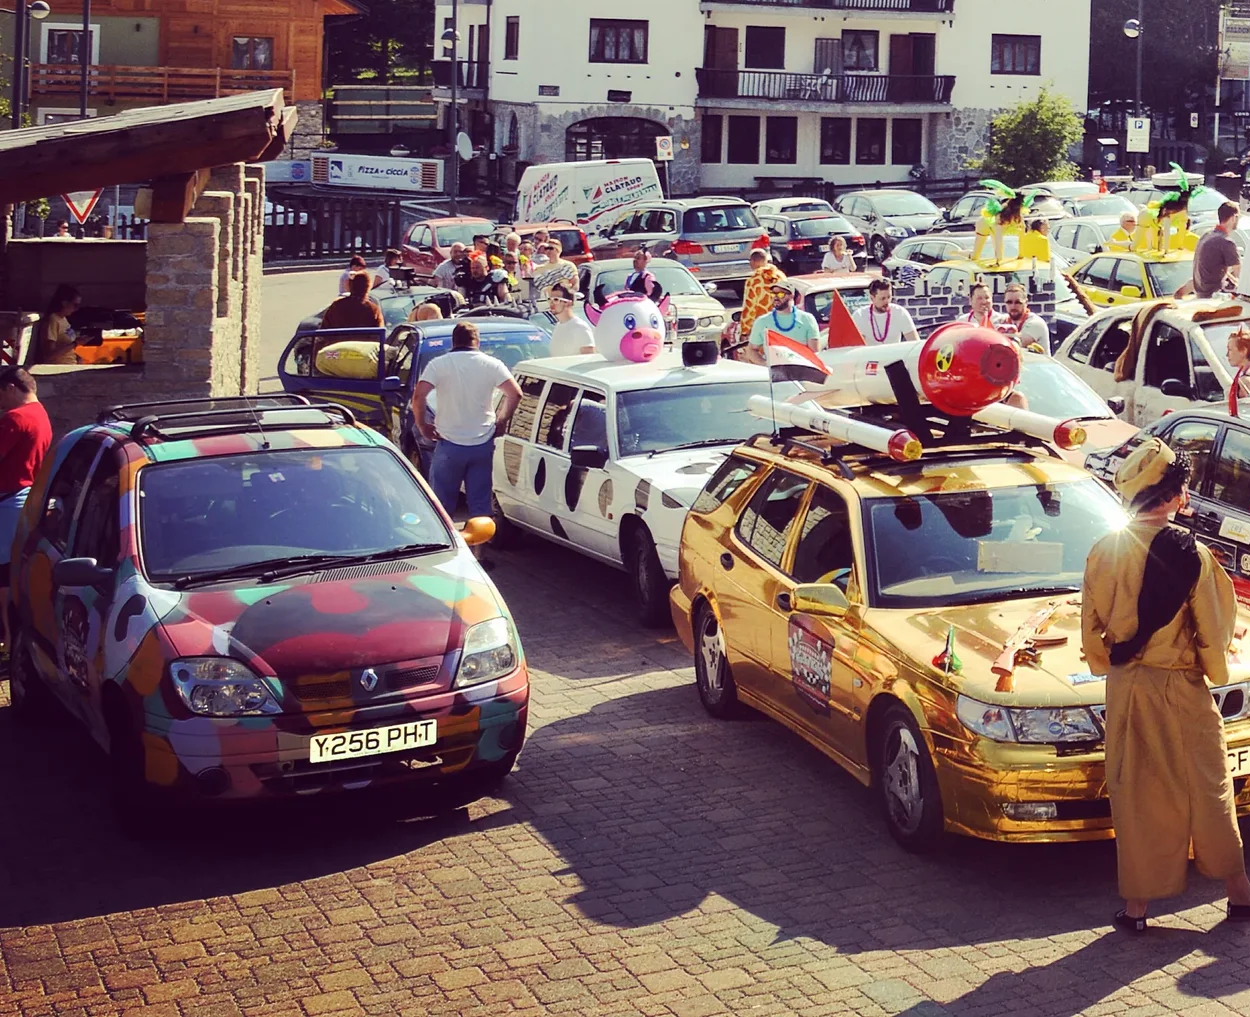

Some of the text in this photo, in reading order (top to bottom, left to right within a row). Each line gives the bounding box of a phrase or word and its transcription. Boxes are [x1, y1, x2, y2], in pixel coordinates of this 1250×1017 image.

[605, 176, 642, 194] CLATAUD
[315, 721, 434, 757] Y256 PHT
